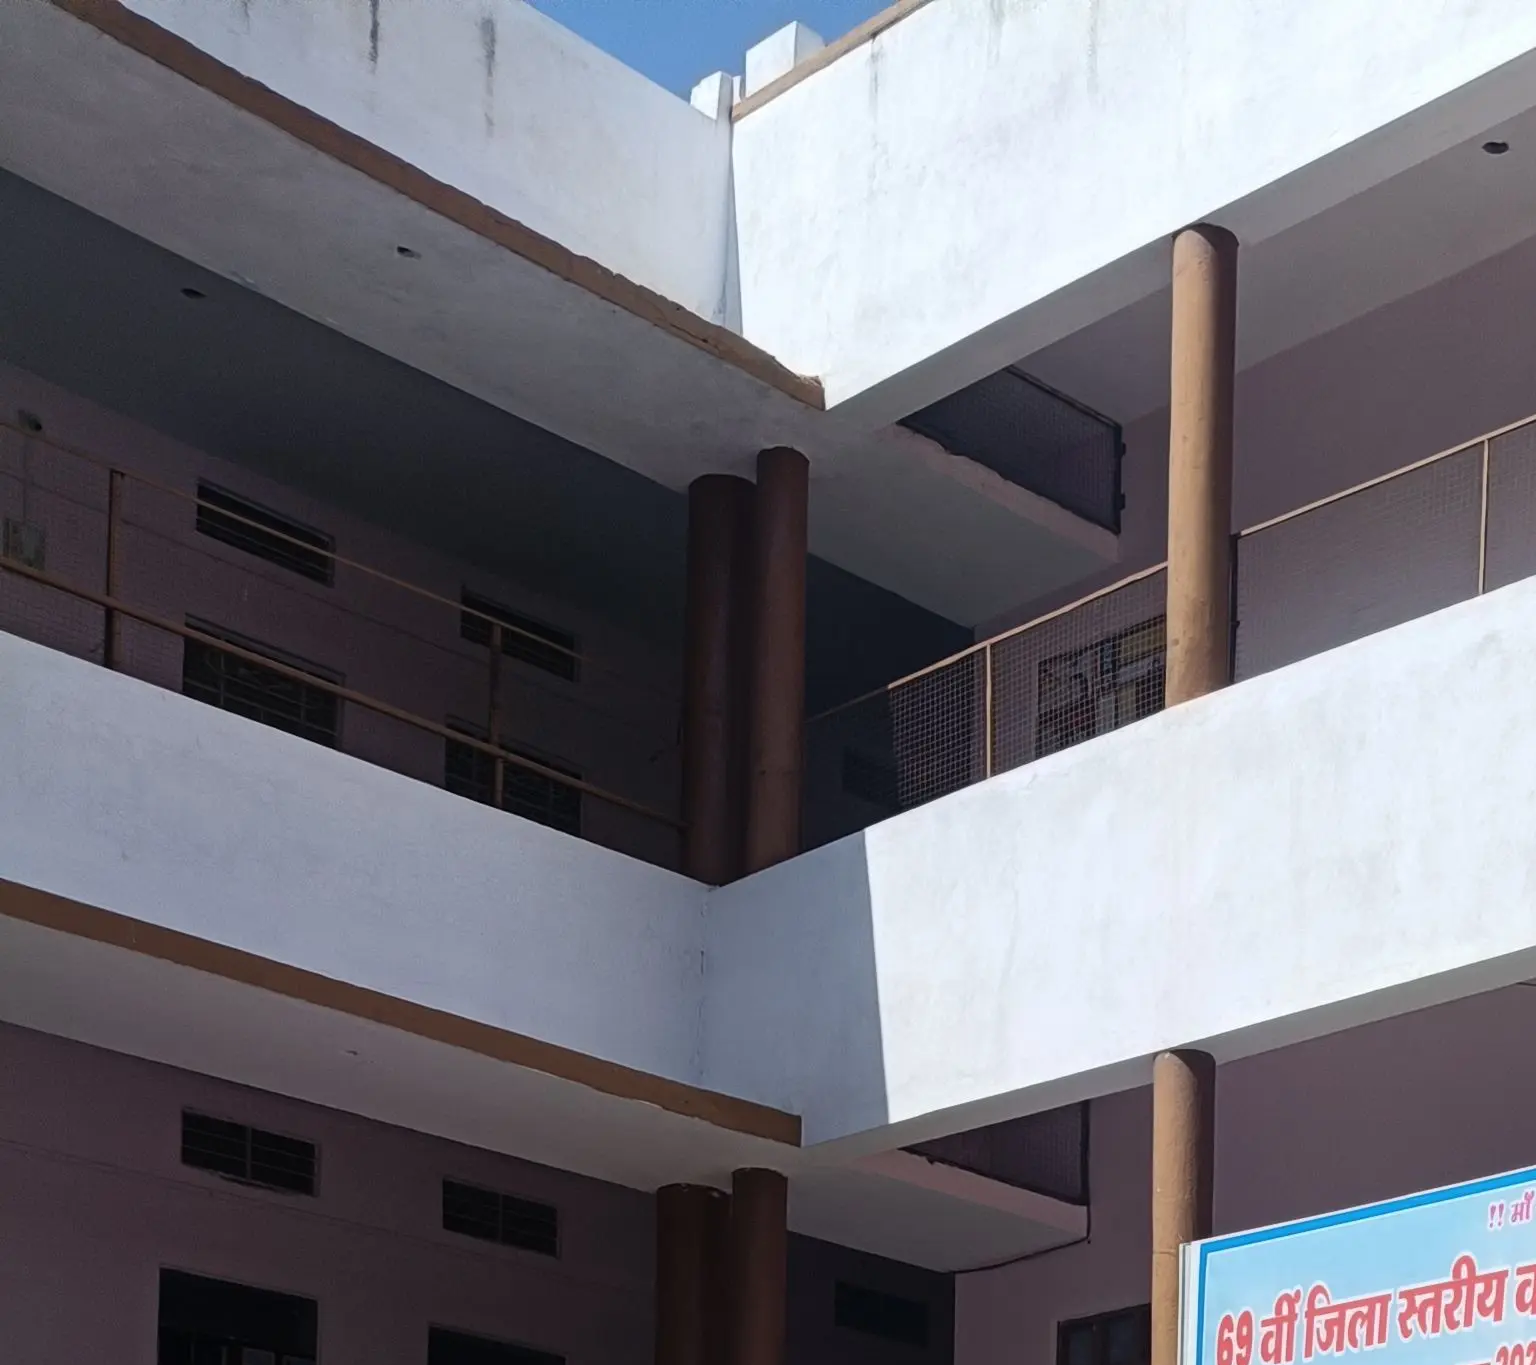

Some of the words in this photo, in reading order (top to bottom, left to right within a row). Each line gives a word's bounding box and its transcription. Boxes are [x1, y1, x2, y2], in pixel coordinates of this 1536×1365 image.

[1260, 1289, 1302, 1364] वीं
[1305, 1284, 1392, 1358] जिला
[1398, 1255, 1509, 1338] स्तरीय
